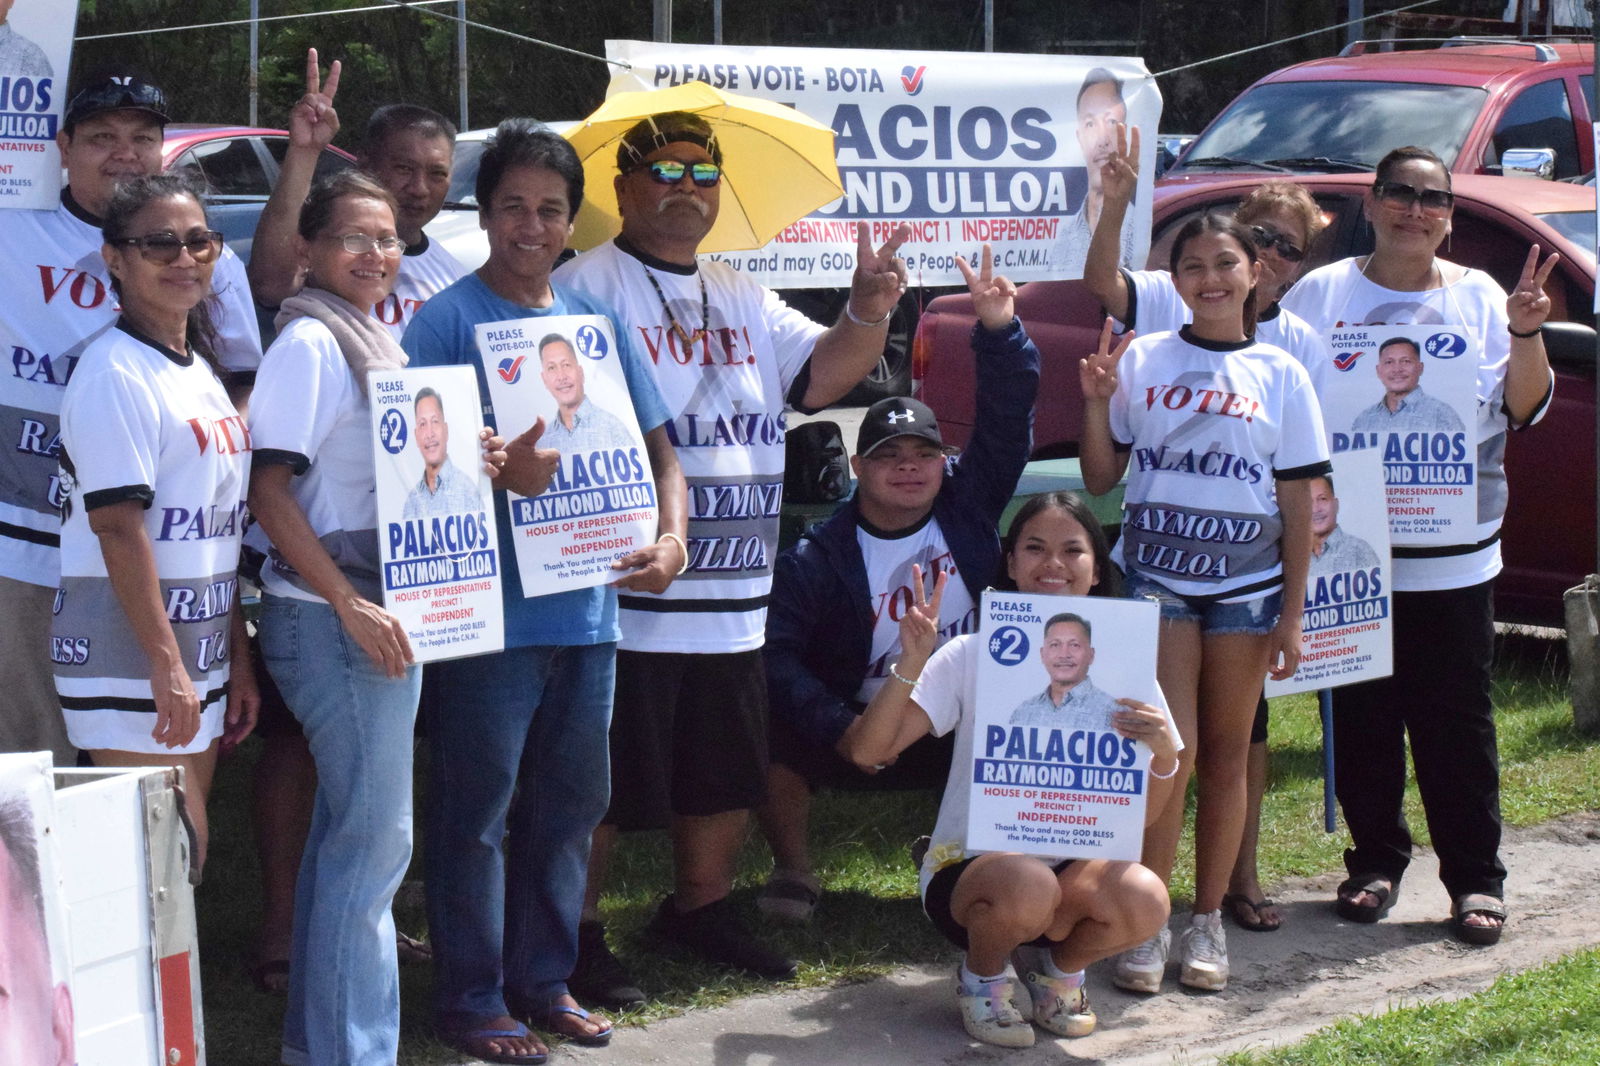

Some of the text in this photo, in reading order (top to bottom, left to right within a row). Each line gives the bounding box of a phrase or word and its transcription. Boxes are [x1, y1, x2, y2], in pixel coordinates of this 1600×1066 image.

[654, 64, 738, 89] PLEASE
[745, 65, 805, 91] VOTE
[825, 67, 884, 92] BOTA
[831, 103, 1057, 161] ACIOS
[0, 143, 45, 152] NTATIVES
[926, 170, 1068, 213] ULLOA
[774, 218, 1059, 243] RESENTATIVE PRINCT 1 INDEPENDENT
[748, 254, 778, 271] and
[784, 257, 815, 274] may
[820, 253, 853, 271] GOD
[920, 252, 966, 273] Peop
[1005, 249, 1049, 266] C.N.M.I.
[487, 329, 524, 341] PLEASE
[578, 326, 603, 358] #2
[1332, 333, 1368, 341] PLEASE
[489, 341, 535, 352] VOTE-BOTA
[637, 326, 756, 366] VOTE!
[1331, 341, 1376, 349] VOTE-BOTA
[1427, 333, 1455, 357] #2
[376, 381, 404, 392] PLEASE
[377, 394, 412, 404] VOTE-BOTA
[1145, 384, 1259, 424] VOTE!
[380, 412, 403, 447] #2
[547, 447, 644, 492] LACIOS
[1418, 465, 1467, 483] ULLOA
[520, 485, 652, 523] RAYMOND ULLOA
[1388, 507, 1435, 515] PENDENT
[526, 511, 652, 537] HOUSE OF REPRESENTATIVES
[1133, 508, 1262, 544] AYMOND
[388, 512, 489, 560] PALACIOS
[573, 529, 610, 540] PRECINCT
[561, 536, 633, 556] INDEPENDENT
[390, 553, 493, 587] RAYMOND ULLOA
[543, 561, 565, 571] Thank
[566, 560, 580, 568] You
[597, 556, 612, 565] may
[1138, 543, 1229, 578] ULLOA
[558, 571, 569, 579] the
[571, 568, 595, 577] People
[395, 581, 492, 602] HOUSE OF REPRESENTATIVES
[1304, 567, 1382, 608] LACIOS
[431, 598, 458, 608] PRECINCT
[990, 601, 1032, 613] PLEASE
[422, 608, 474, 624] INDEPENDENT
[990, 613, 1042, 623] VOTE-BOTA
[1302, 600, 1382, 630] MOND ULLOA
[1302, 622, 1381, 643] OF REPRESENTATIVES
[990, 629, 1022, 661] #2
[1311, 639, 1340, 649] PRECINCT
[1298, 645, 1359, 663] INDEPENDENT
[1341, 658, 1355, 666] GOD
[1356, 655, 1372, 663] BLESS
[1305, 672, 1324, 681] People
[985, 725, 1137, 768] PALACIOS
[983, 762, 1135, 791] RAYMOND ULLOA
[984, 787, 1130, 806] HOUSE OF REPRESENTATIVES
[1034, 802, 1074, 811] PRECINCT
[1017, 811, 1098, 826] INDEPENDENT
[995, 823, 1114, 839] Thank You and may GOD BLESS
[1022, 834, 1048, 844] People
